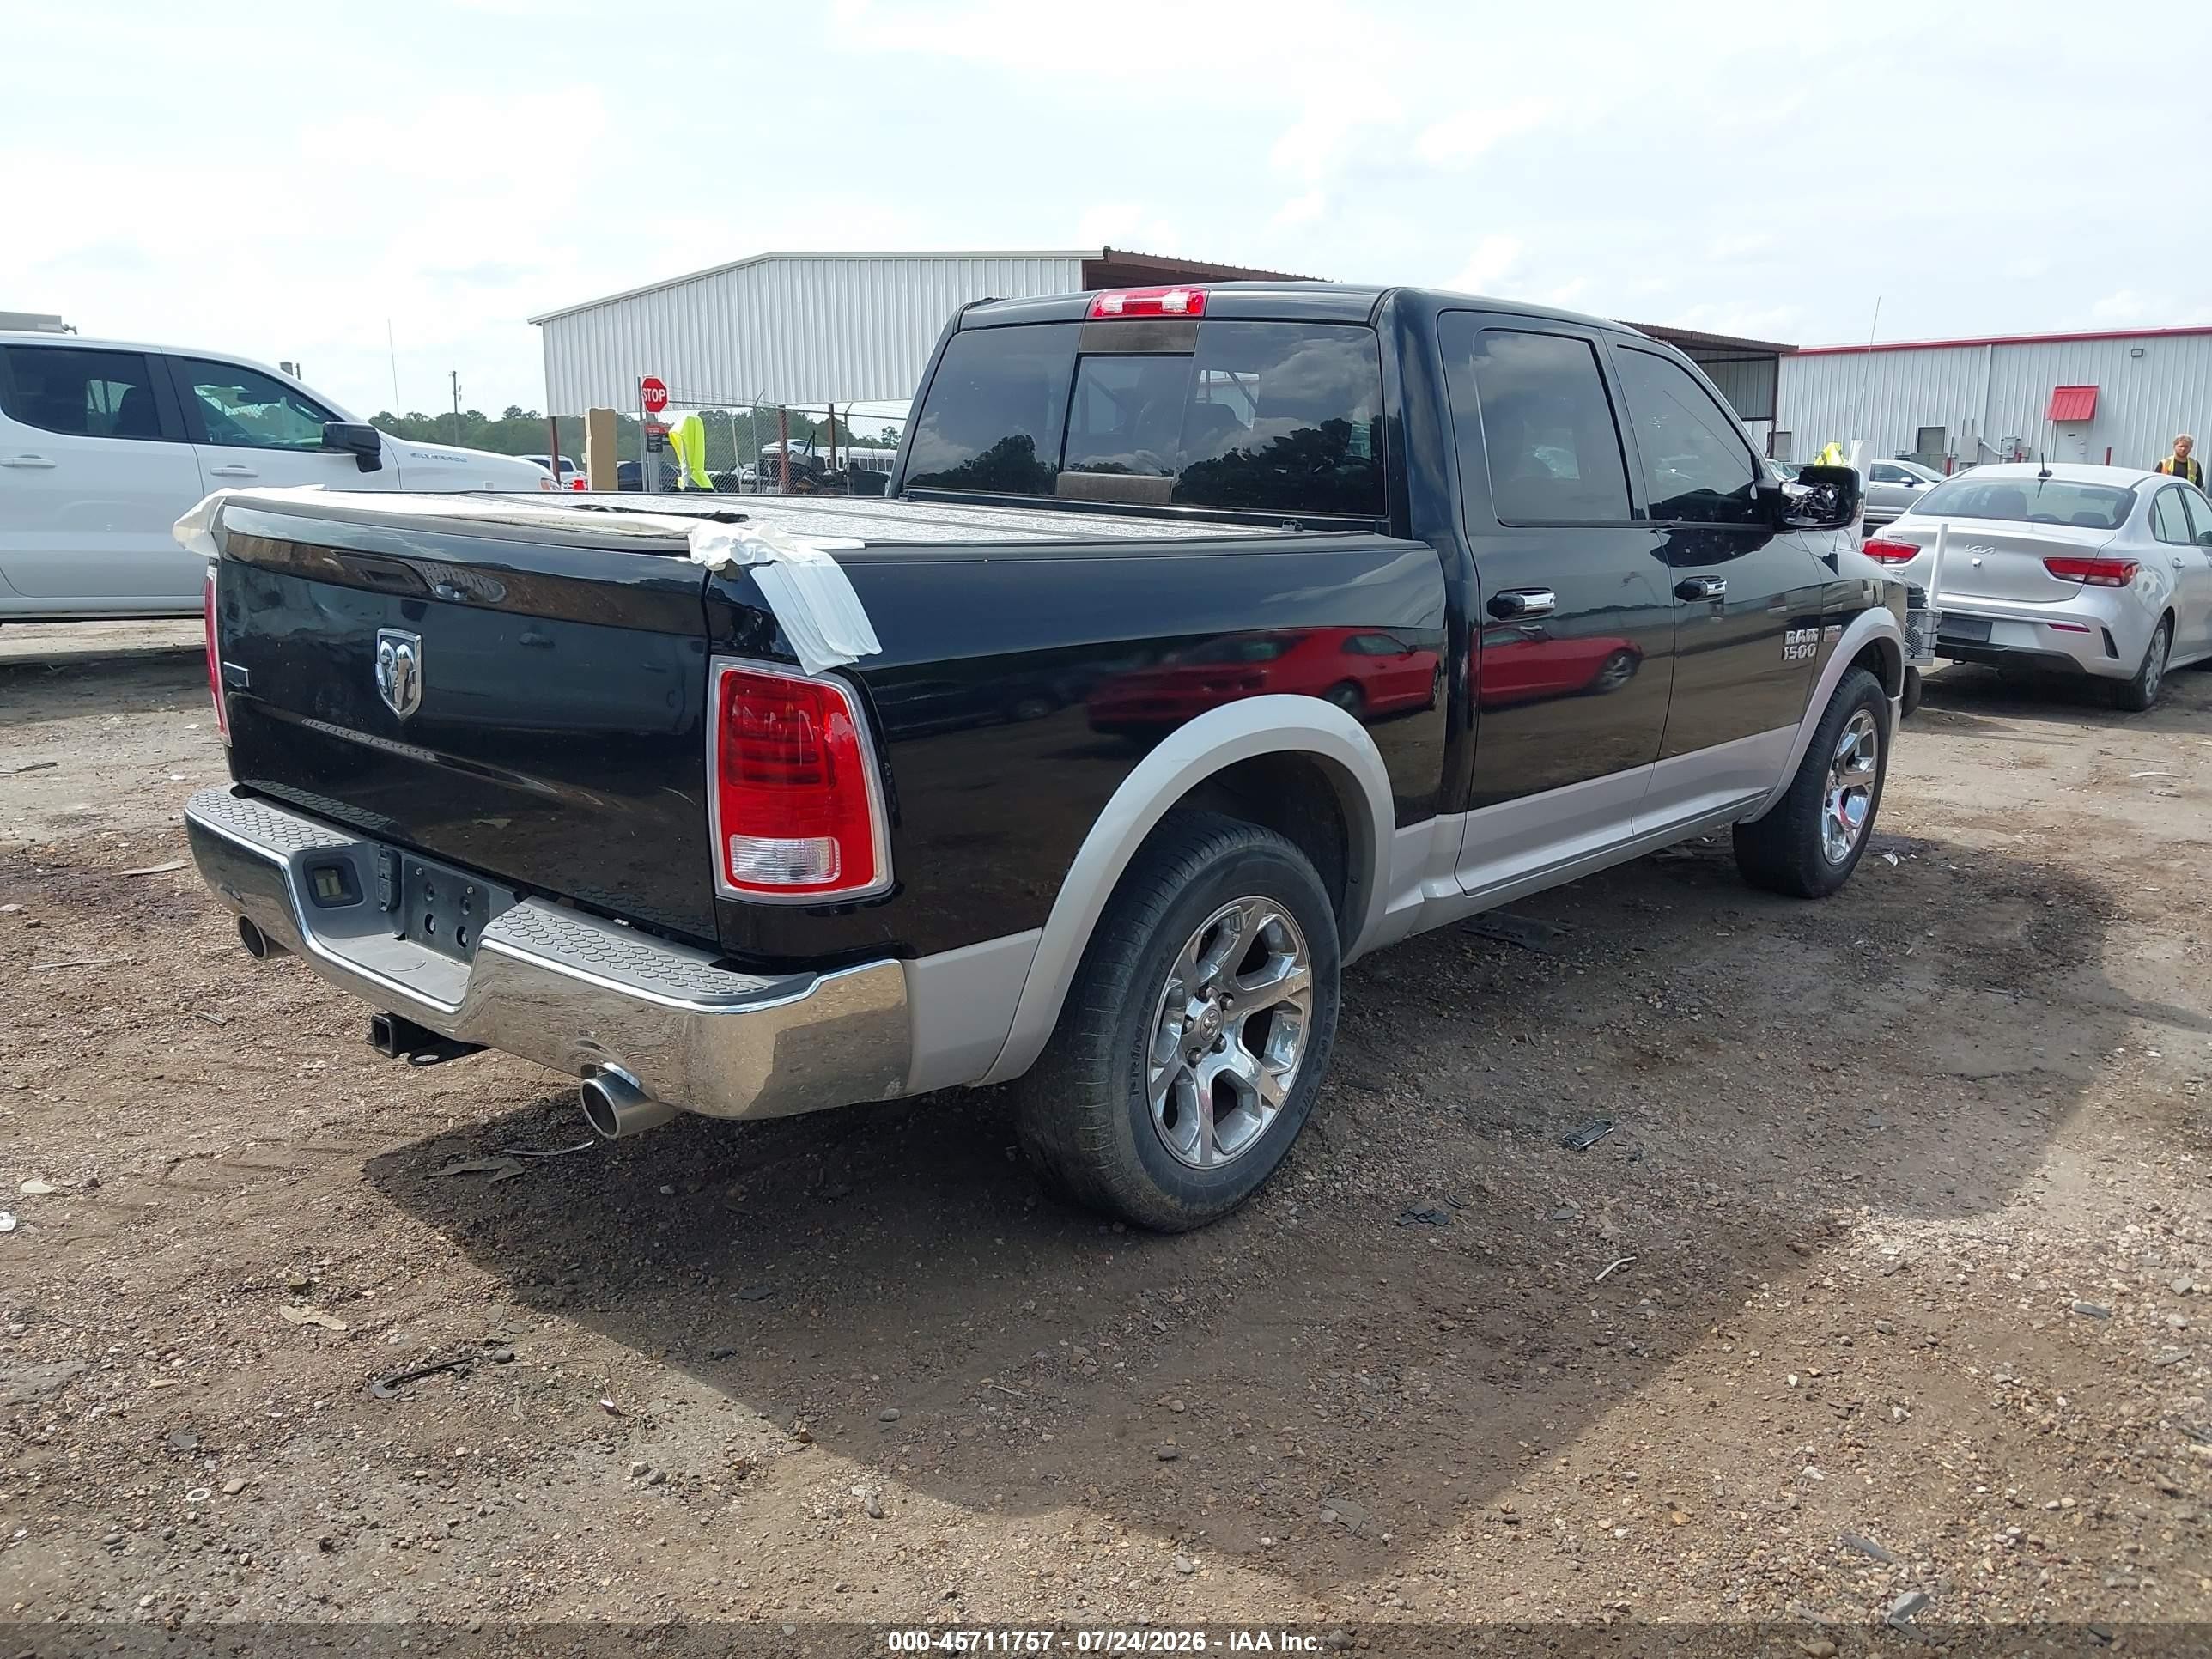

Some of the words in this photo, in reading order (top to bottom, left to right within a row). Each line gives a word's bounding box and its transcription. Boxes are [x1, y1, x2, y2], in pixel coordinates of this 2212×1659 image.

[642, 388, 665, 403] STOP
[1785, 628, 1820, 645] RAM
[1783, 643, 1817, 661] 1500
